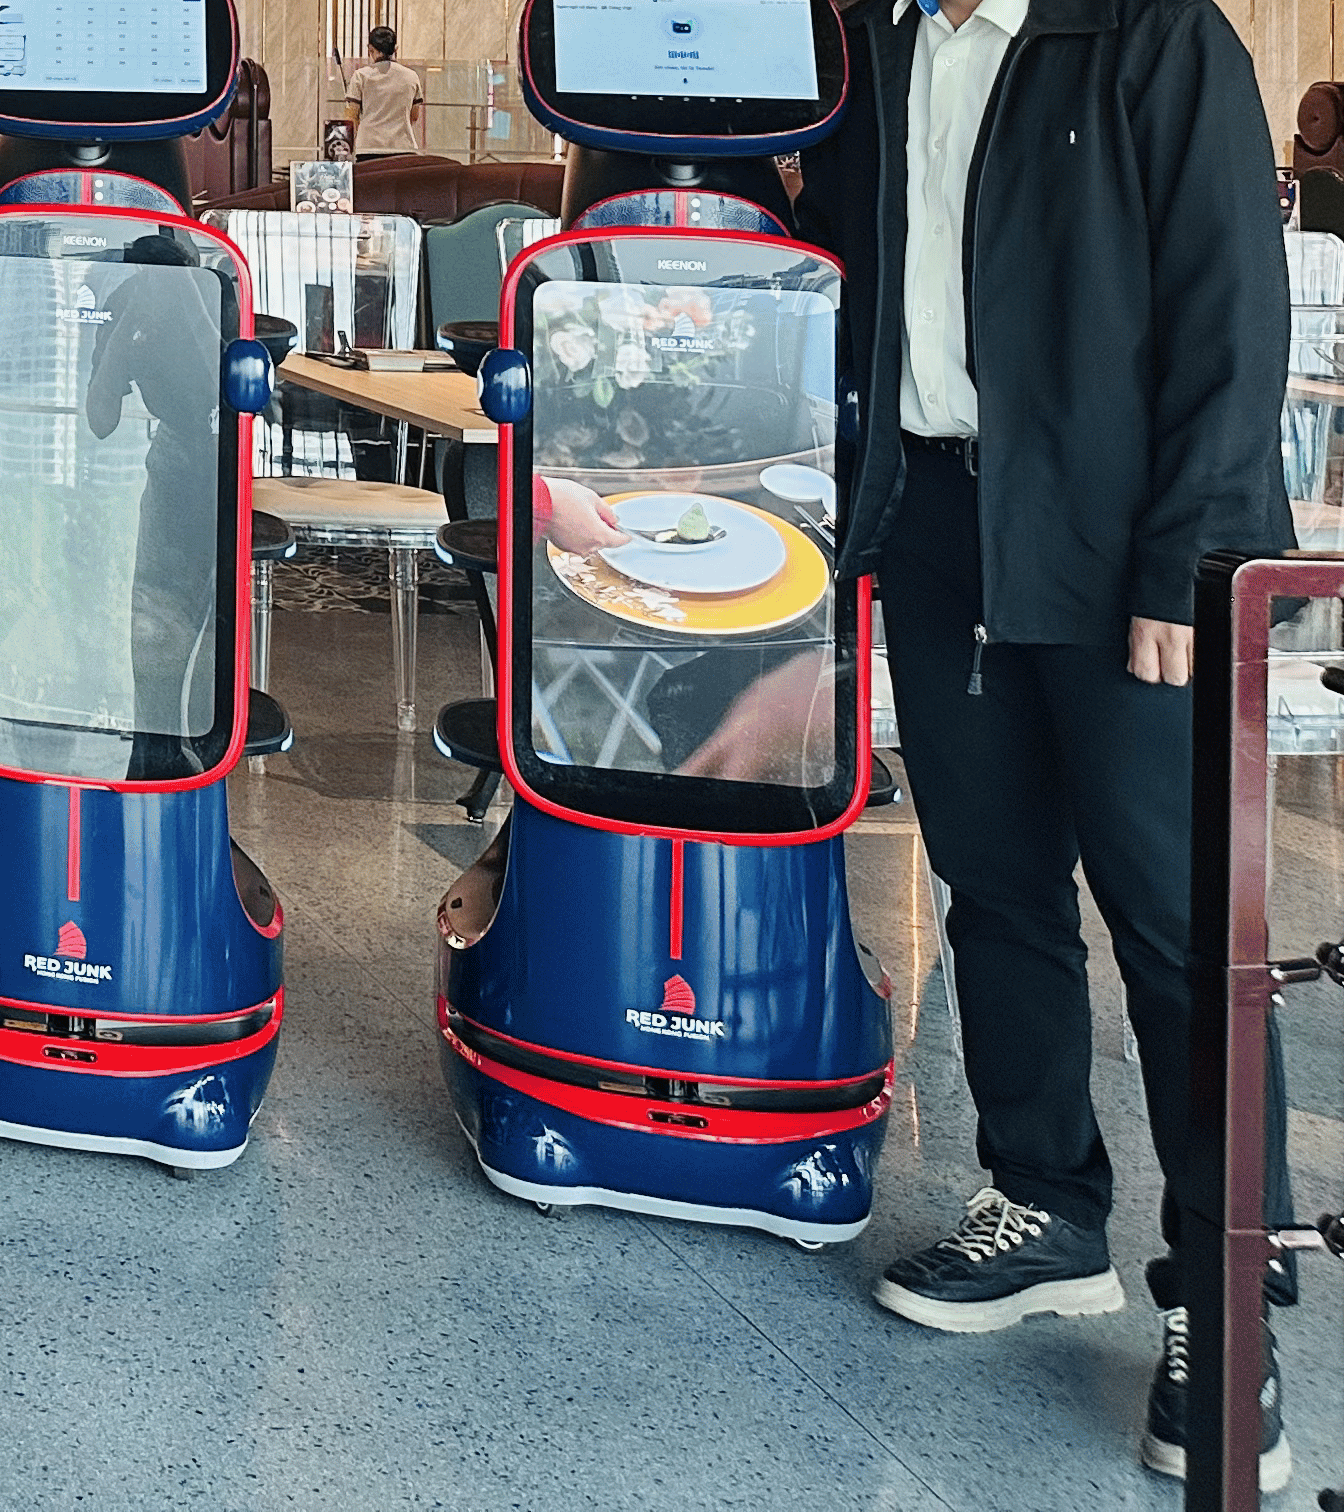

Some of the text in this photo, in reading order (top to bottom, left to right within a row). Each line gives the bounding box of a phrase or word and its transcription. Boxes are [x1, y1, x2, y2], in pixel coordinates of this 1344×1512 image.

[63, 235, 107, 247] KEENON
[657, 259, 707, 271] KEENON
[652, 337, 714, 350] RED JUNK
[23, 954, 61, 972] RED
[63, 960, 113, 981] JUNK
[625, 1008, 668, 1028] RED
[670, 1016, 725, 1037] JUNK
